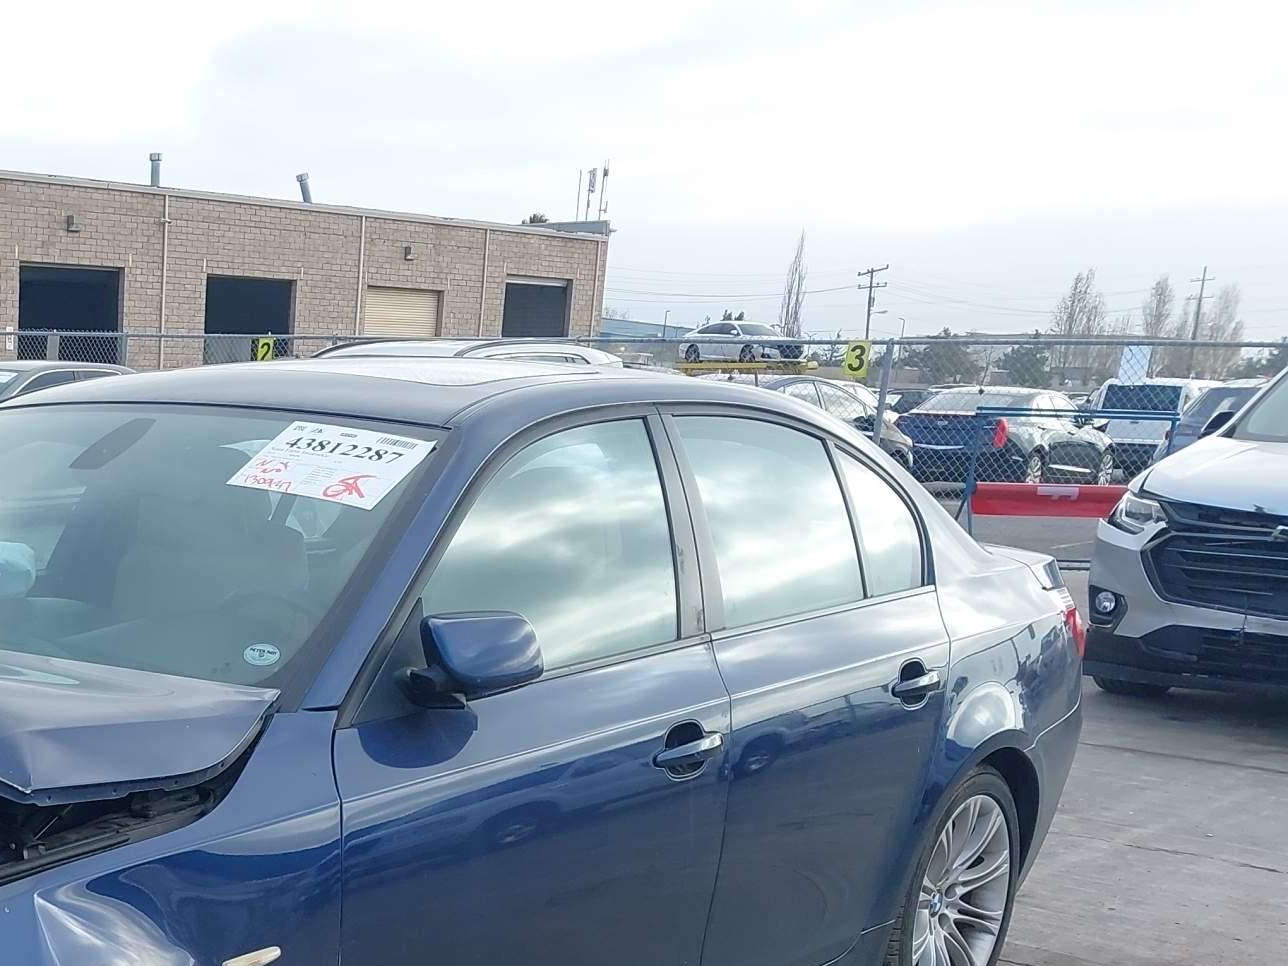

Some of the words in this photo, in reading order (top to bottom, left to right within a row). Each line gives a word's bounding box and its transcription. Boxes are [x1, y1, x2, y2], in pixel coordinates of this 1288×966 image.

[261, 342, 271, 361] 2
[847, 344, 866, 372] 3
[285, 436, 406, 464] 43812287
